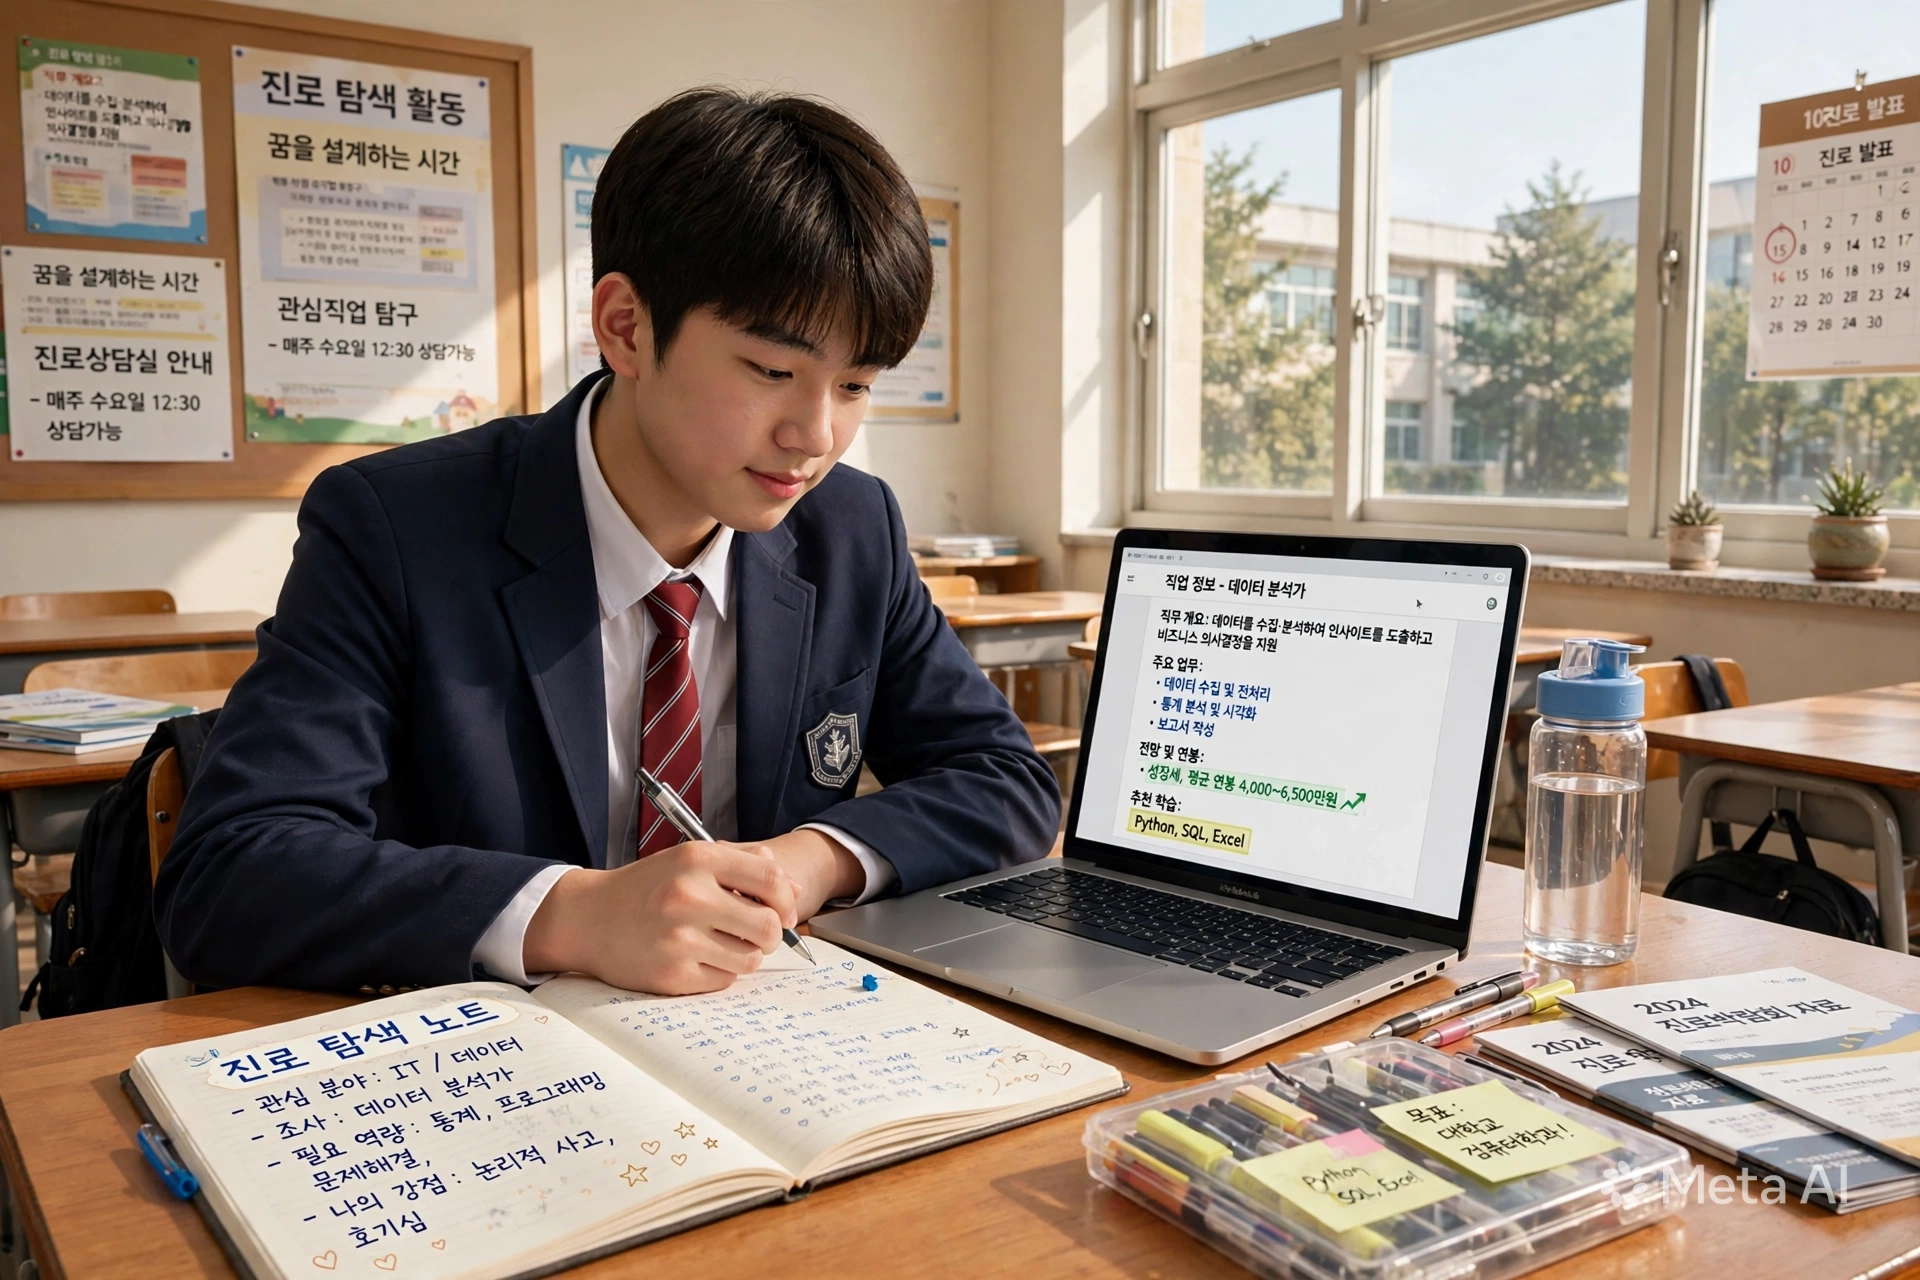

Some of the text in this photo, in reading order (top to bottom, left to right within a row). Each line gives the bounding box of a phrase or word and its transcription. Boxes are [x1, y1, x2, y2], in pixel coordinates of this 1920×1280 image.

[261, 70, 465, 126] 진로 탐색 활동
[1867, 95, 1905, 121] 발표
[268, 132, 315, 161] 꿈을
[417, 149, 461, 176] 시간
[1773, 157, 1791, 175] 10
[1819, 140, 1894, 168] 진로 발표
[1825, 216, 1833, 228] 2
[1851, 213, 1858, 225] 7
[1875, 210, 1883, 222] 8
[1773, 244, 1786, 257] 15
[1800, 243, 1807, 255] 8
[1824, 242, 1831, 253] 9
[1872, 236, 1886, 249] 12
[1899, 233, 1913, 247] 17
[33, 264, 199, 293] 꿈을 설계하는 시간
[1796, 268, 1809, 281] 15
[1821, 267, 1834, 279] 16
[1846, 265, 1858, 277] 18
[1871, 262, 1884, 275] 19
[1897, 260, 1910, 272] 19
[1794, 294, 1808, 307] 22
[1818, 292, 1833, 305] 20
[1869, 289, 1884, 301] 23
[1894, 287, 1910, 300] 24
[278, 296, 418, 327] 관심직업 탐구
[1793, 320, 1807, 332] 29
[1866, 315, 1882, 328] 30
[34, 345, 213, 375] 진로상담실 안내
[283, 337, 315, 356] 매주
[319, 339, 366, 358] 수요일
[372, 342, 414, 358] 12:30
[418, 342, 476, 361] 상담가능
[47, 391, 84, 411] 매주
[90, 392, 145, 412] 수요일
[152, 395, 200, 411] 12:30
[47, 421, 123, 441] 상담가능
[1165, 574, 1189, 591] 직업
[1192, 576, 1216, 592] 정보
[1228, 578, 1265, 596] 데이터
[1267, 580, 1307, 600] 분석가
[1160, 609, 1181, 625] 직무
[1183, 611, 1209, 626] 개요:
[1212, 614, 1253, 631] 데이터를
[1328, 623, 1384, 642] 인사이트를
[1386, 629, 1433, 645] 도출하고
[1157, 629, 1278, 652] 비즈니스 의사결정을 지원
[1152, 655, 1174, 670] 주요
[1164, 676, 1271, 702] 데이터 수집 및 전처리
[1161, 696, 1257, 722] 통계 분석 및 시각화
[1157, 717, 1215, 737] 보고서 작성
[1139, 741, 1204, 764] 전망 및 연봉:
[1148, 763, 1339, 809] 성장세, 평균 연봉 4,000~6,500만원
[1130, 789, 1182, 812] 추천 학습:
[1134, 814, 1245, 848] Python, SQL, Excel
[1633, 997, 1710, 1015] 2024
[1655, 998, 1852, 1034] 진로박람회 자료
[220, 1002, 500, 1083] 진로 탐색 노트
[1531, 1036, 1603, 1056] 2024
[255, 1087, 311, 1114] 관심
[389, 1060, 422, 1080] IT
[450, 1036, 523, 1063] 데이터
[354, 1087, 432, 1117] 데이터
[443, 1067, 514, 1099] 분석가
[292, 1142, 348, 1167] 필요
[495, 1071, 606, 1114] 프로그래밍
[1437, 1117, 1504, 1140] 대학교
[329, 1192, 384, 1217] 나의
[472, 1145, 547, 1181] 논리적
[348, 1211, 428, 1249] 호기심
